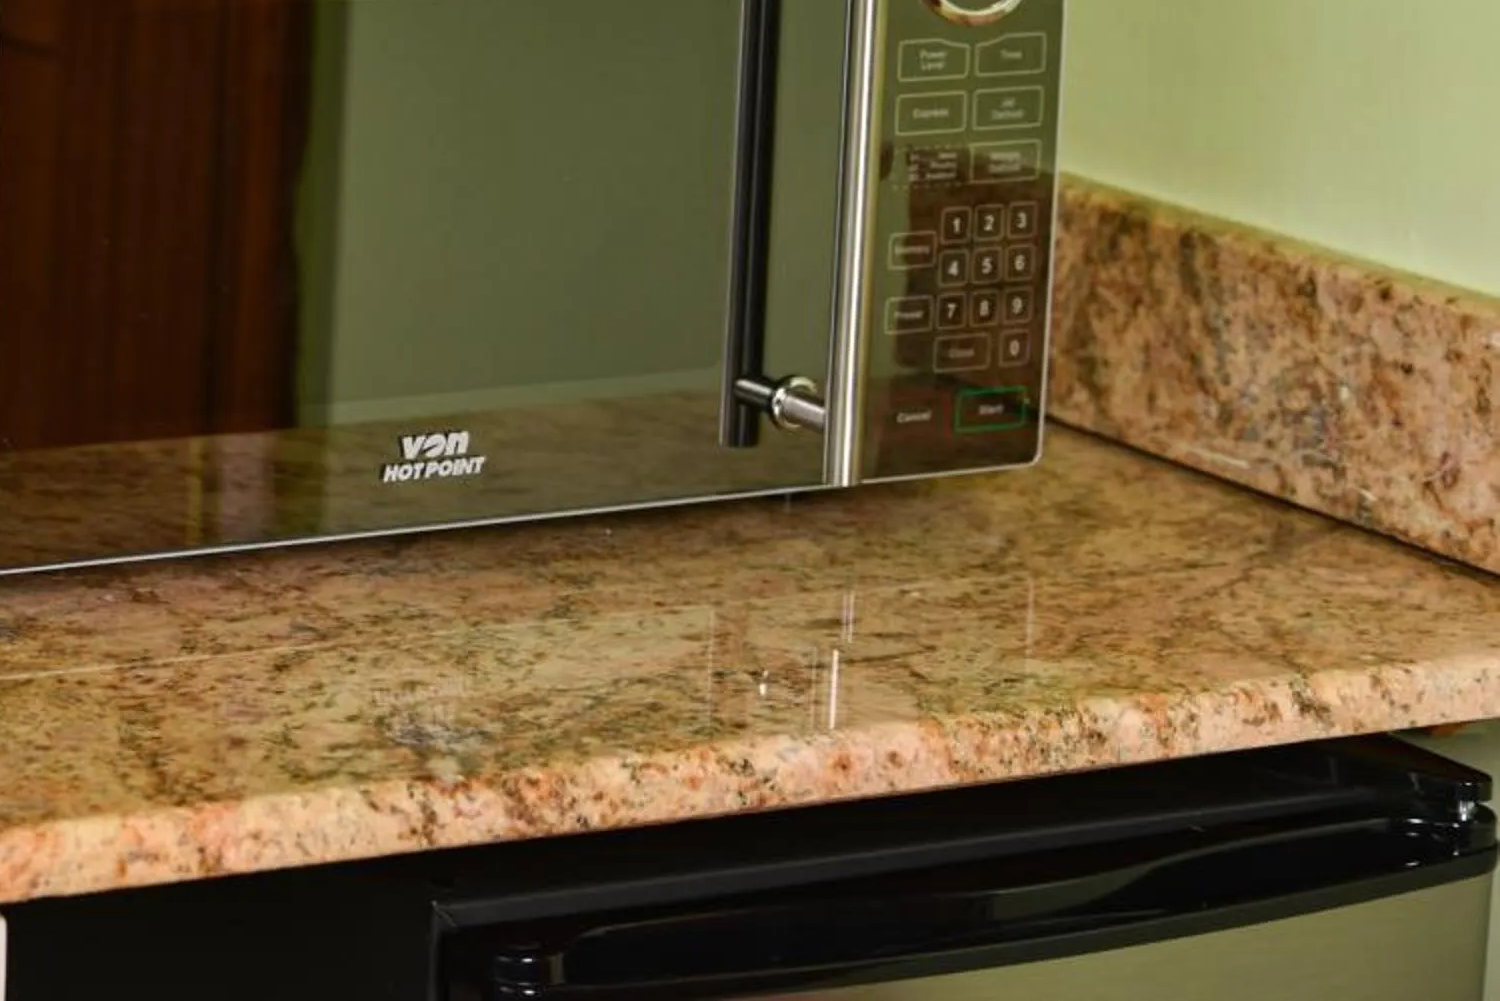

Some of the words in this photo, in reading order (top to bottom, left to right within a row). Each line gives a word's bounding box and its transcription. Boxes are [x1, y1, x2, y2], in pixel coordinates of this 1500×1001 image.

[953, 217, 962, 234] 1
[983, 214, 996, 232] 2
[1016, 211, 1028, 230] 3
[947, 260, 960, 277] 4
[981, 256, 993, 275] 5
[1014, 254, 1026, 272] 6
[947, 302, 957, 319] 7
[979, 299, 990, 317] 8
[1012, 296, 1023, 315] 9
[1009, 339, 1021, 356] 0
